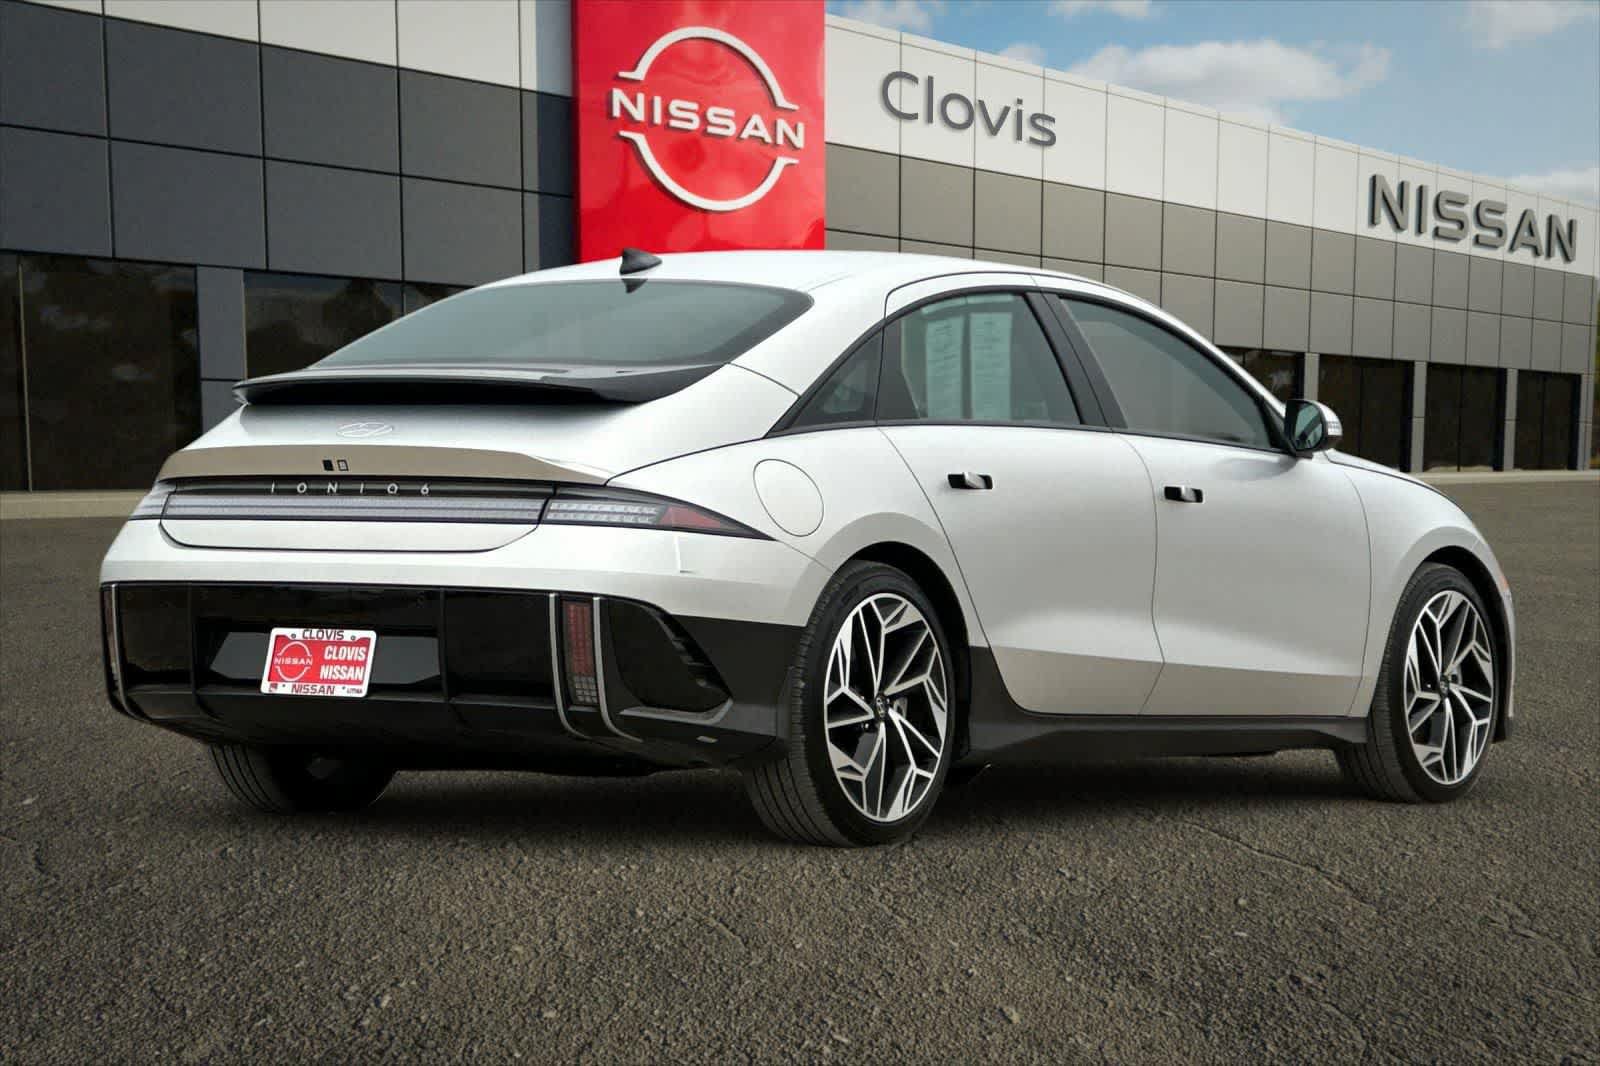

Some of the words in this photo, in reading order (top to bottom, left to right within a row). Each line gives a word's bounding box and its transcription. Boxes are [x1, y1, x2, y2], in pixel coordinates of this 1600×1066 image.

[881, 70, 1057, 147] Clovis
[610, 87, 806, 149] NISSAN
[1368, 173, 1577, 263] NISSAN
[302, 629, 345, 640] CLOVIS
[325, 646, 366, 660] CLOVIS
[274, 656, 312, 665] NISSAN
[320, 665, 364, 680] NISSAN
[291, 684, 335, 695] NISSAN
